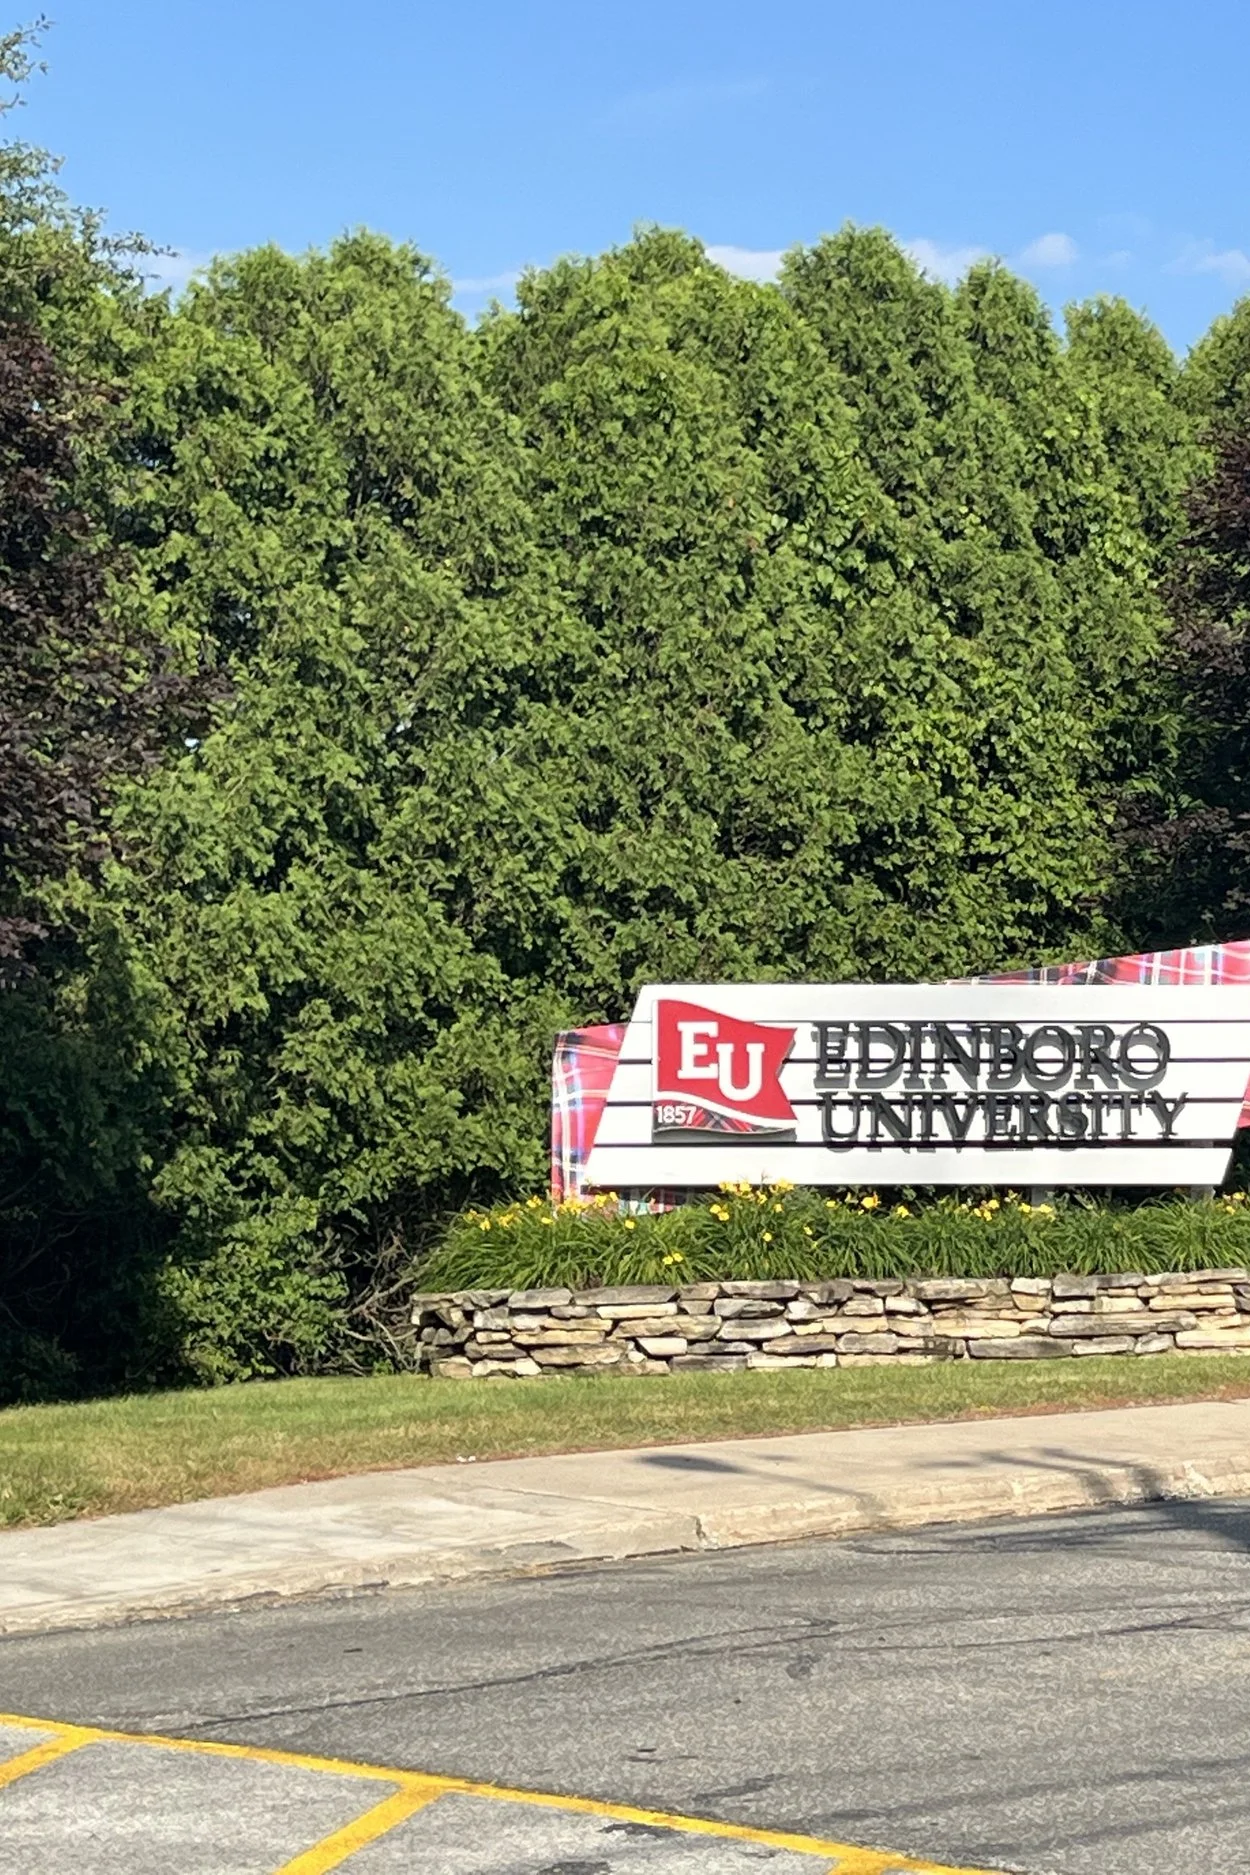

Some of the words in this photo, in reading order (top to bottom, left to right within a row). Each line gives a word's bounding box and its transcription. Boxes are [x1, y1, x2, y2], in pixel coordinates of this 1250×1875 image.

[677, 1021, 765, 1102] EU
[816, 1021, 1171, 1079] EDINBORO
[656, 1105, 697, 1125] 1857
[817, 1091, 1187, 1140] UNIVERSITY
